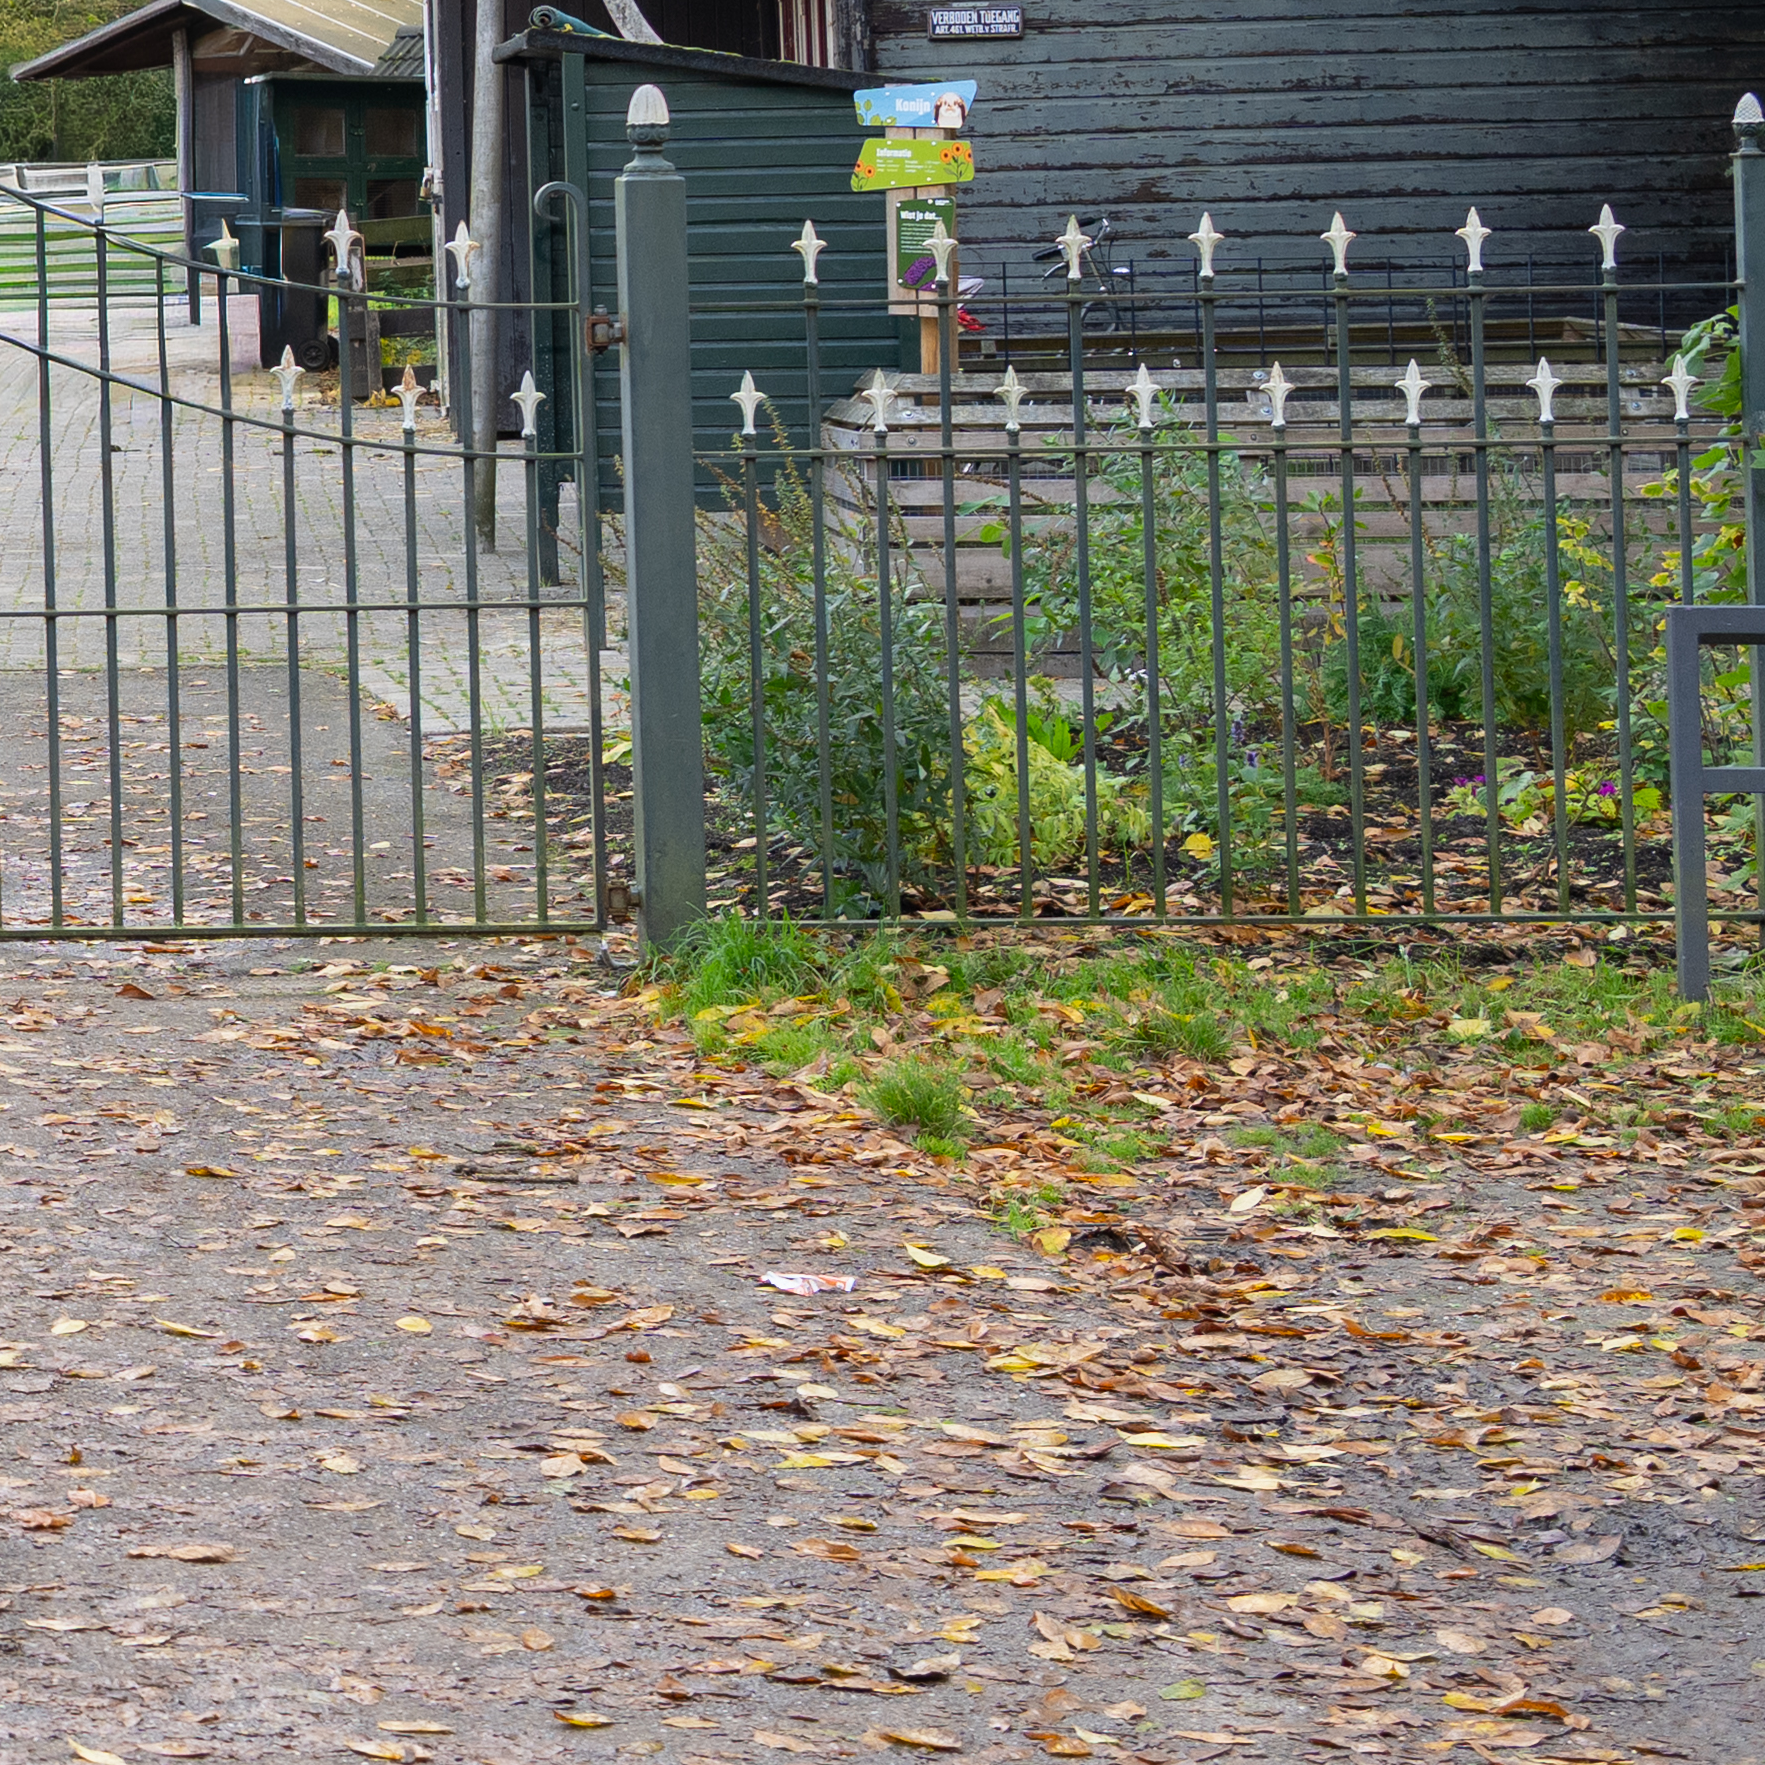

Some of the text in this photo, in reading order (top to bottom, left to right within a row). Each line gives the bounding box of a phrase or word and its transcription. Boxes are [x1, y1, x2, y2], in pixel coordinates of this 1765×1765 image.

[932, 10, 1020, 25] VERBODEN TOEGANG
[895, 98, 931, 115] Konijn
[876, 147, 912, 158] Informatie
[900, 210, 917, 220] Wist
[916, 210, 924, 222] je
